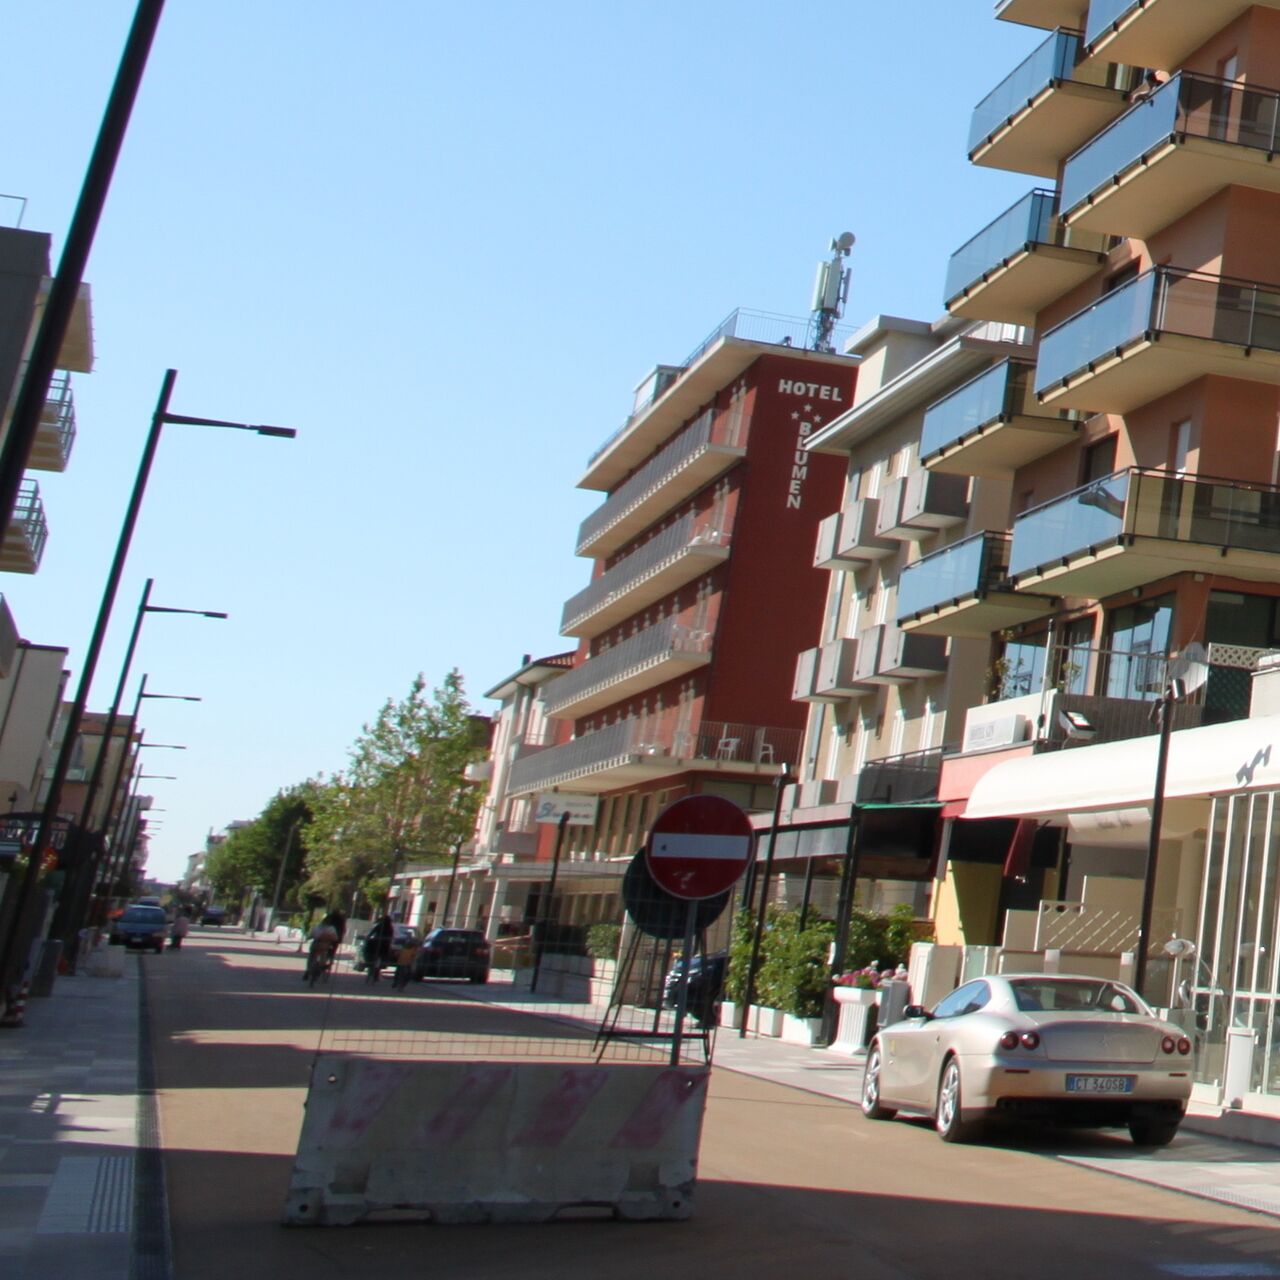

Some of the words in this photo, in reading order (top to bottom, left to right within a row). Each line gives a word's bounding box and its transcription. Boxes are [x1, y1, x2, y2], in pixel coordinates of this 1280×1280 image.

[778, 379, 842, 402] HOTEL
[786, 421, 812, 509] BLUMEN
[1075, 1077, 1089, 1091] CT
